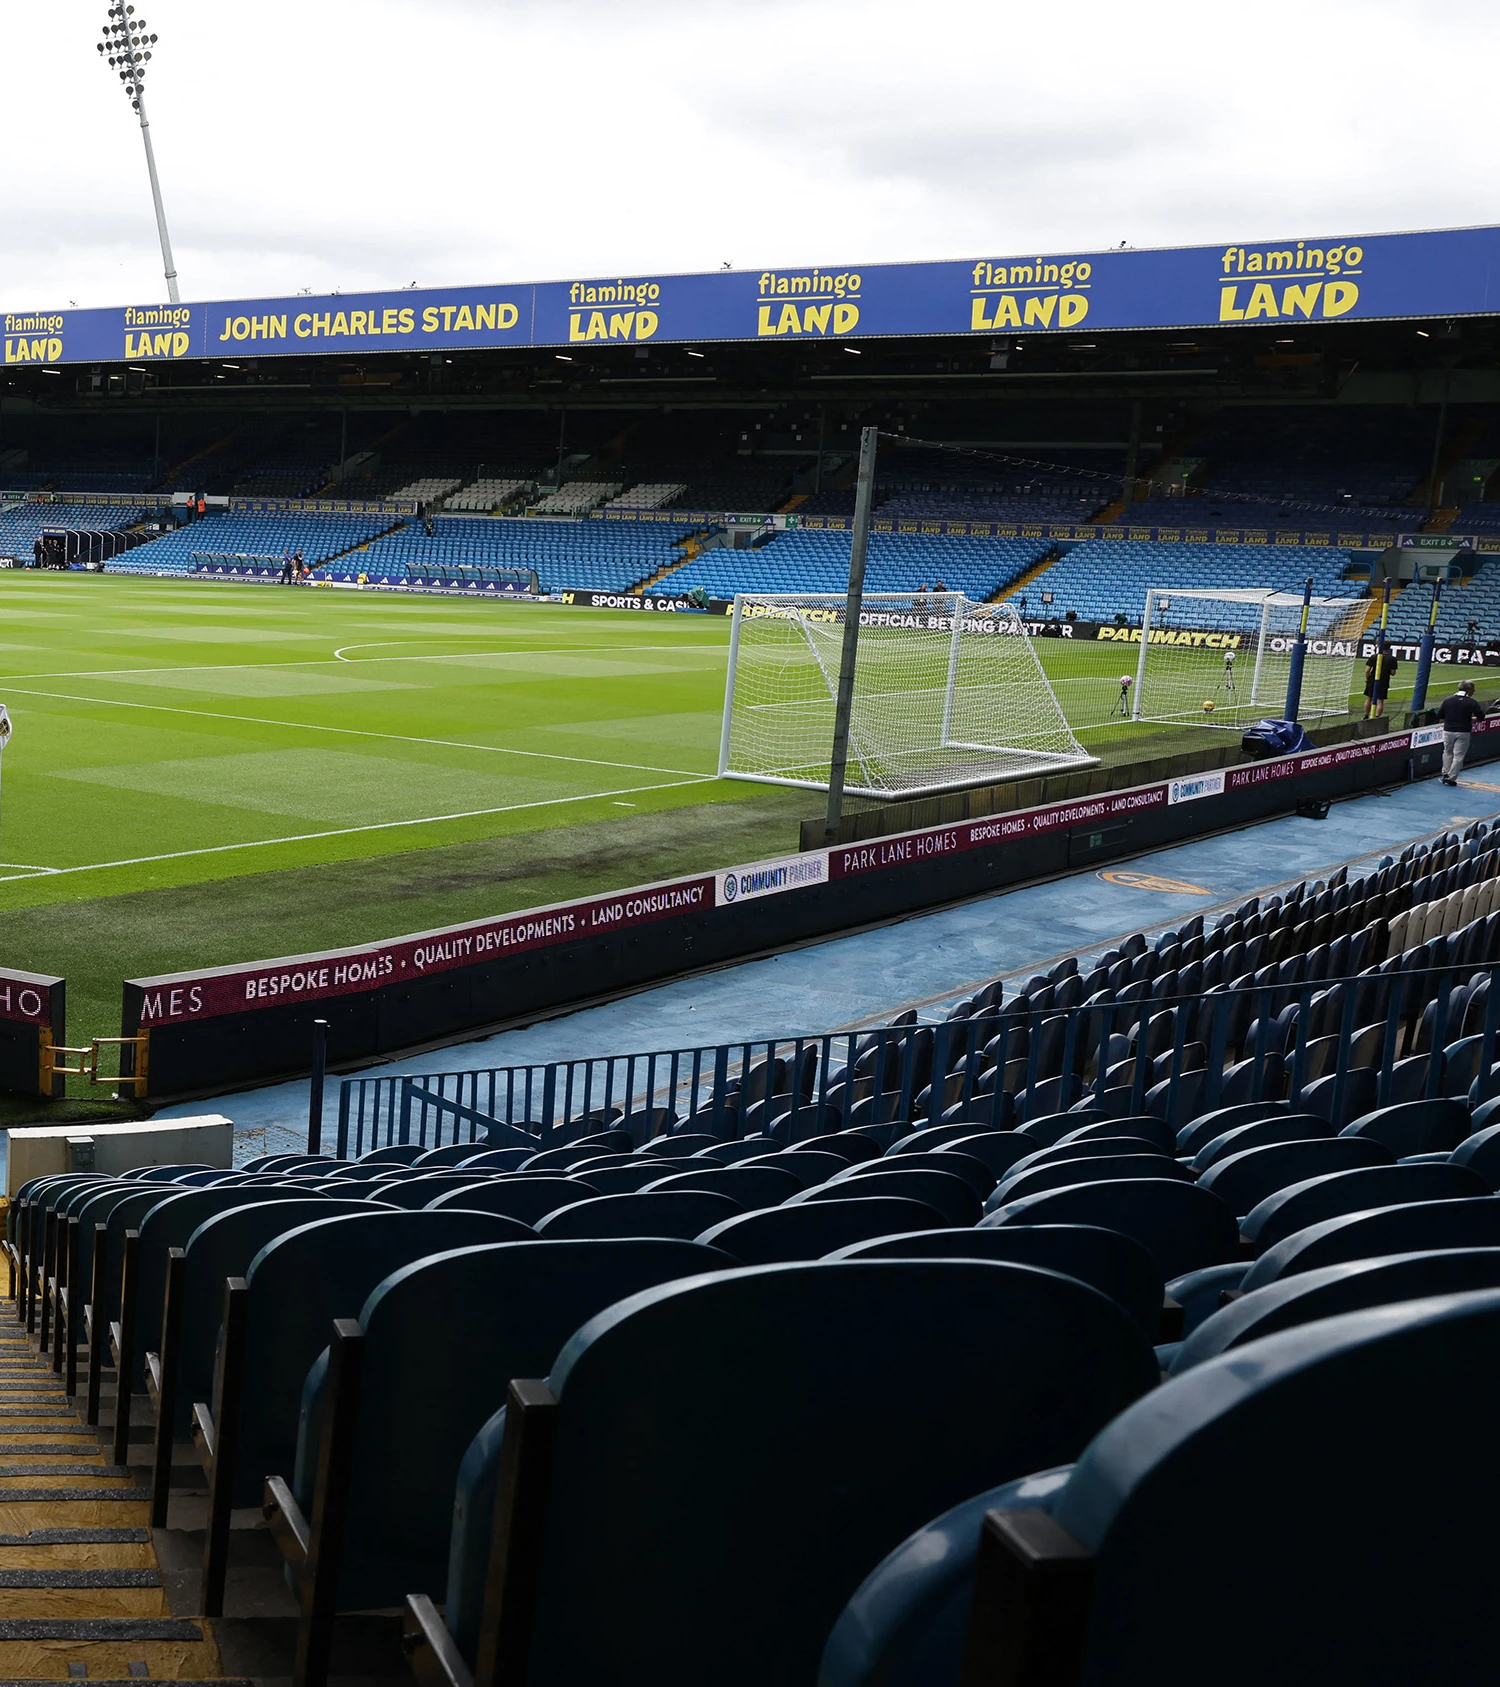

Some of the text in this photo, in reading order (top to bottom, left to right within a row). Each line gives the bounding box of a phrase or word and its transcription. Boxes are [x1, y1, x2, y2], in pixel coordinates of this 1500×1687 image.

[972, 257, 1091, 289] flamingo
[1222, 241, 1363, 276] flamingo
[569, 279, 660, 307] flamingo
[758, 269, 861, 299] flamingo
[124, 304, 191, 328] flamingo
[971, 293, 1090, 330] LAND
[1219, 280, 1360, 322] LAND
[4, 312, 64, 334] flamingo
[219, 303, 519, 342] JOHN CHARLES STAND
[568, 311, 659, 342] LAND
[758, 303, 860, 336] LAND
[4, 337, 63, 362] LAND
[124, 331, 190, 359] LAND
[1244, 536, 1394, 548] LAND LAND LAND LAND LAND
[1420, 538, 1440, 547] EXIT
[591, 595, 641, 609] SPORTS
[643, 598, 654, 610] &
[858, 612, 925, 629] OFFICIAL
[1097, 627, 1241, 649] PARIMATCH
[1180, 780, 1204, 798] COMMUNITY
[1232, 771, 1250, 788] PARK
[1251, 766, 1269, 783] LANE
[1270, 761, 1294, 779] HOMES
[844, 789, 1164, 873] PARK LANE HOMES BESPOKE HOMES QUALITY DEVELOPMENTS LAND CONSULTANCY
[740, 866, 787, 895] COMMUNITY
[141, 885, 704, 1021] MES BESPOKE HOMES QUALITY DEVELOPMENTS LAND CONSULTANCY
